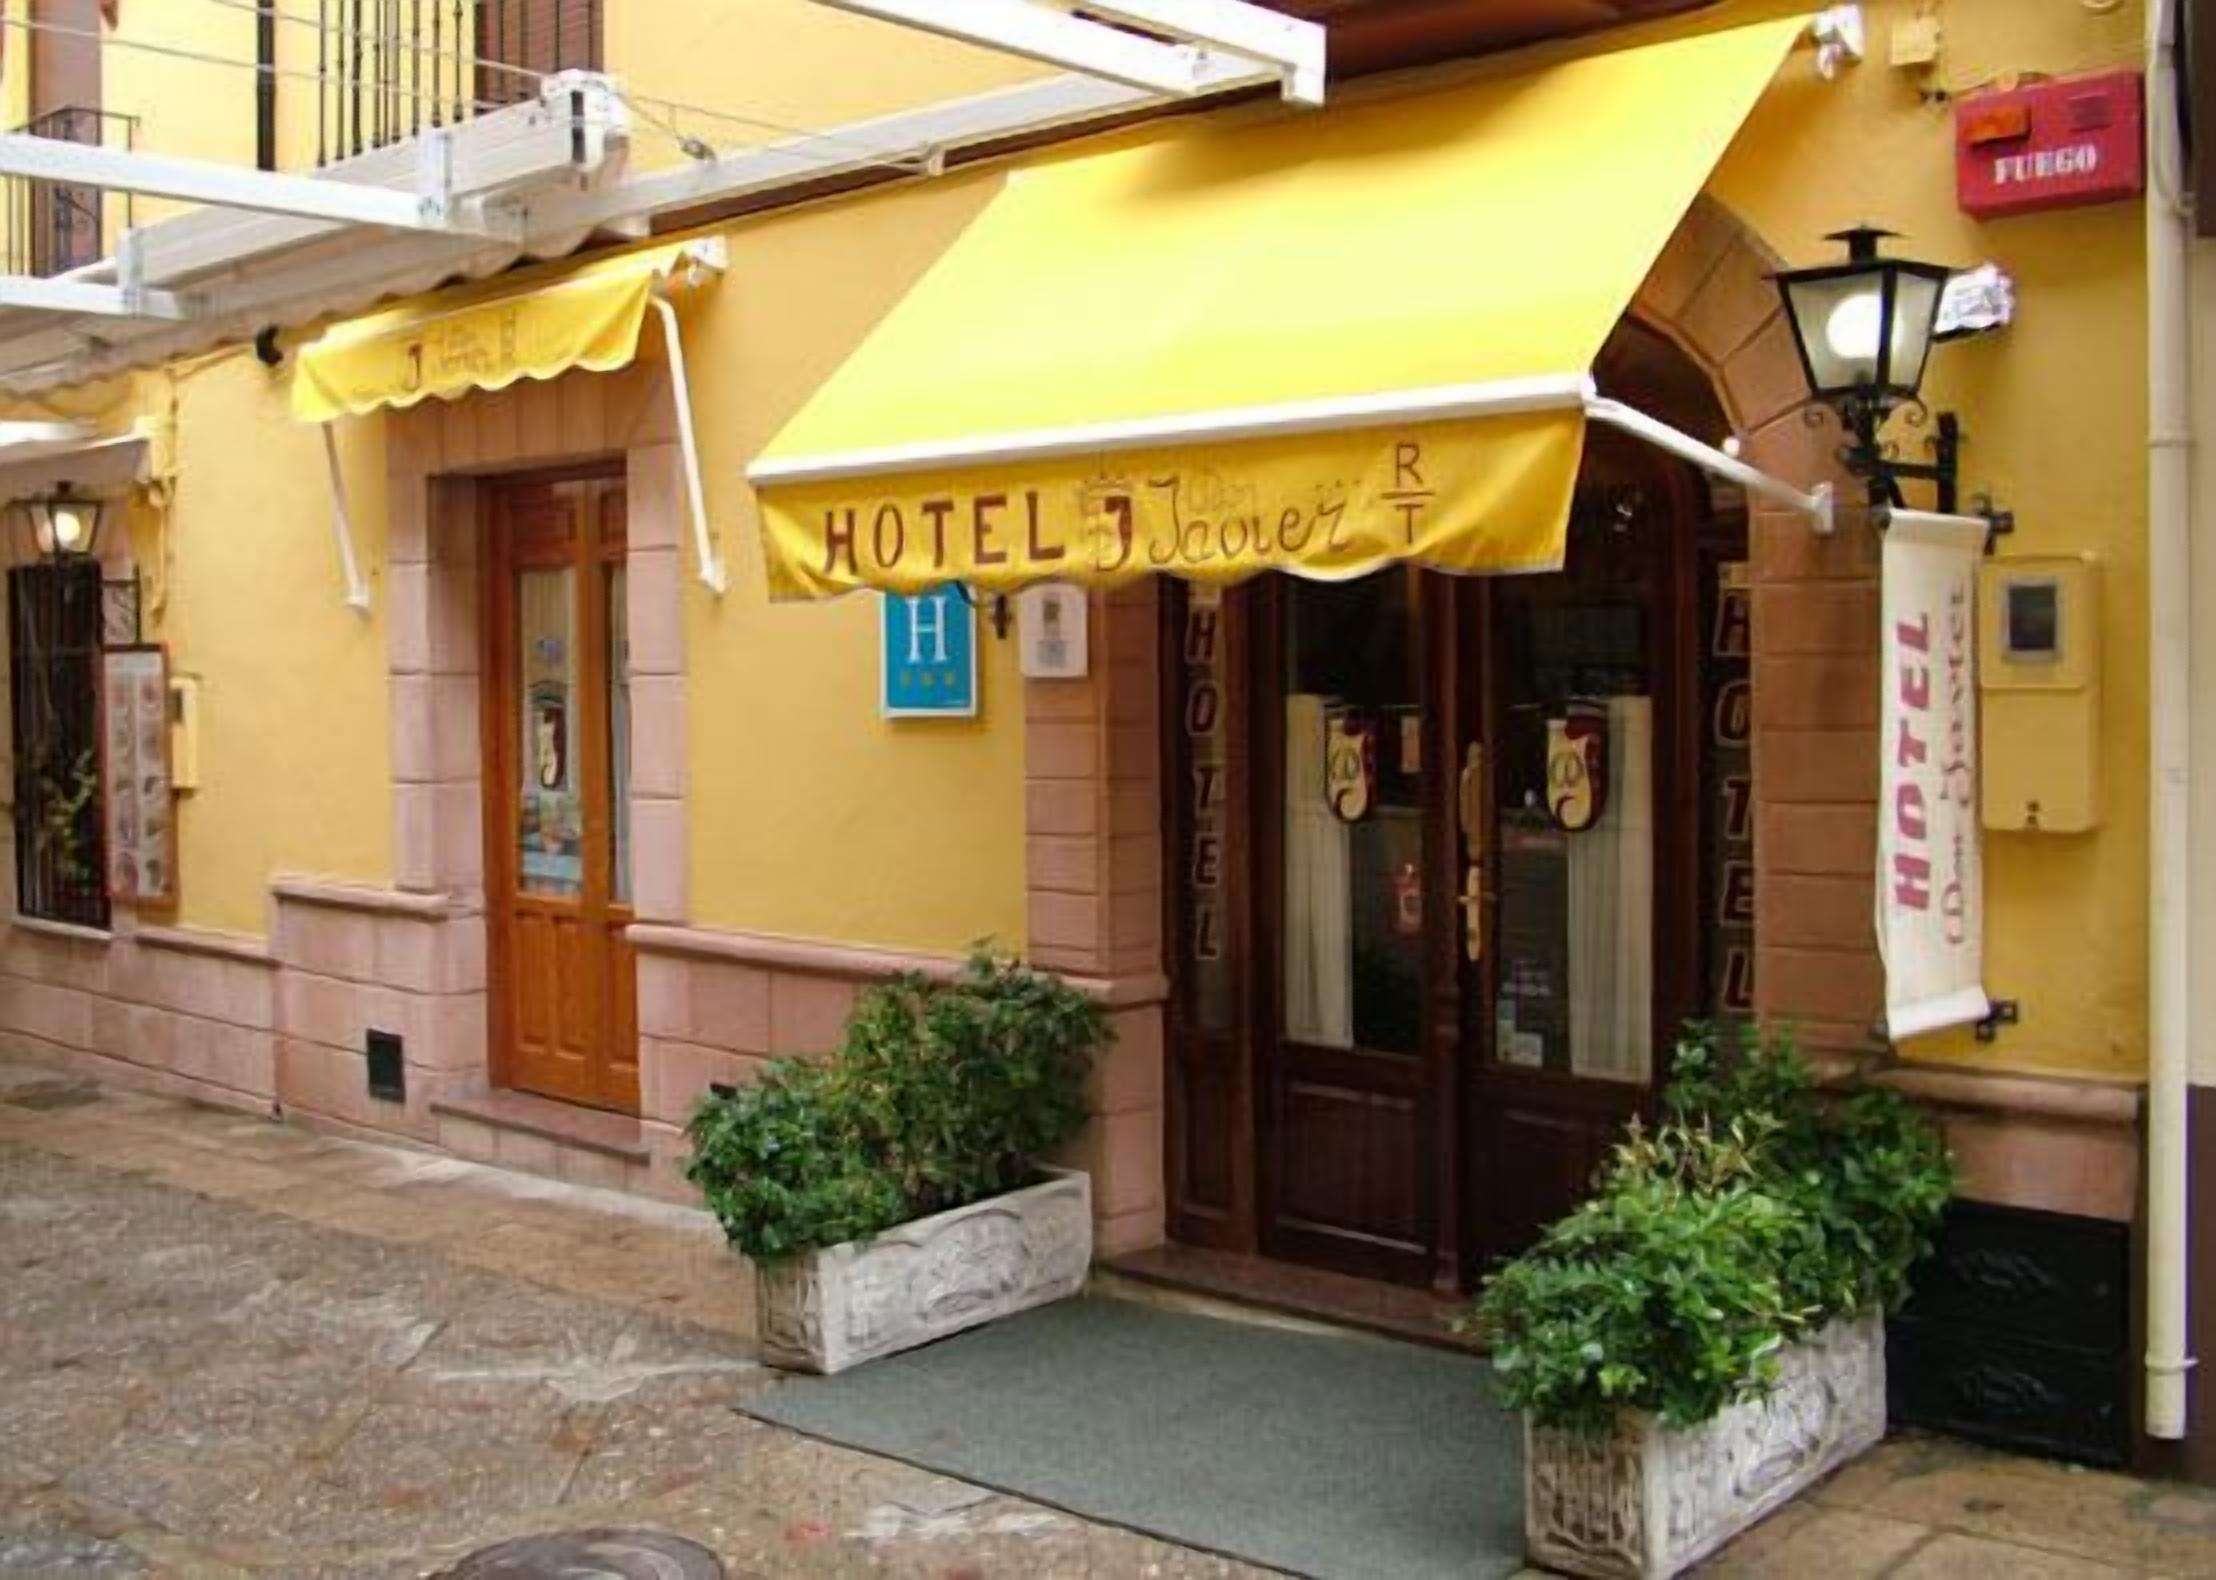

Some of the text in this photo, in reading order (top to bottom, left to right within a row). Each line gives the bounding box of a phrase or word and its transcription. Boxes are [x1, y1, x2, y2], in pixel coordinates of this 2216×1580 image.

[1994, 145, 2097, 185] FUEGO
[1395, 442, 1424, 486] R
[824, 490, 1066, 575] HOTEL
[905, 596, 947, 663] H
[1184, 608, 1224, 961] HOTEL
[1713, 594, 1754, 1012] HOTEL
[1893, 611, 1932, 911] HOTEL
